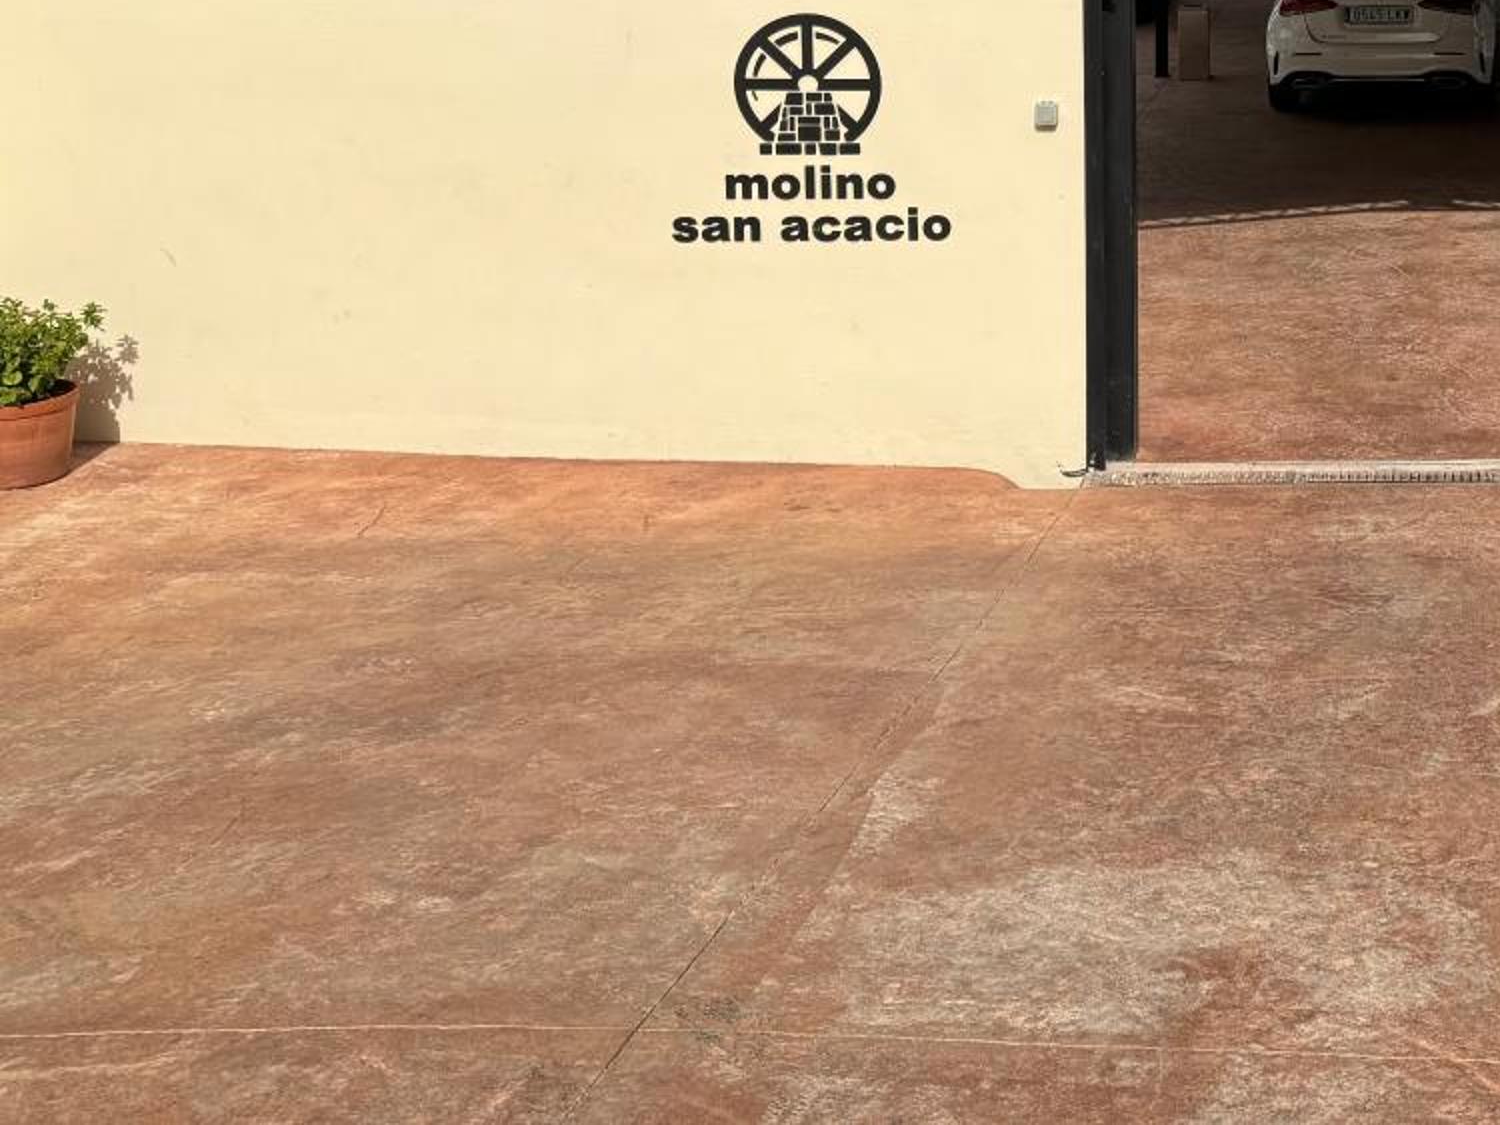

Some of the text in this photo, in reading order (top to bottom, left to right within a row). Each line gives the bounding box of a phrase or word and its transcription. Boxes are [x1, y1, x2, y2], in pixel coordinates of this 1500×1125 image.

[725, 164, 896, 201] molino
[671, 206, 952, 244] san acacio
